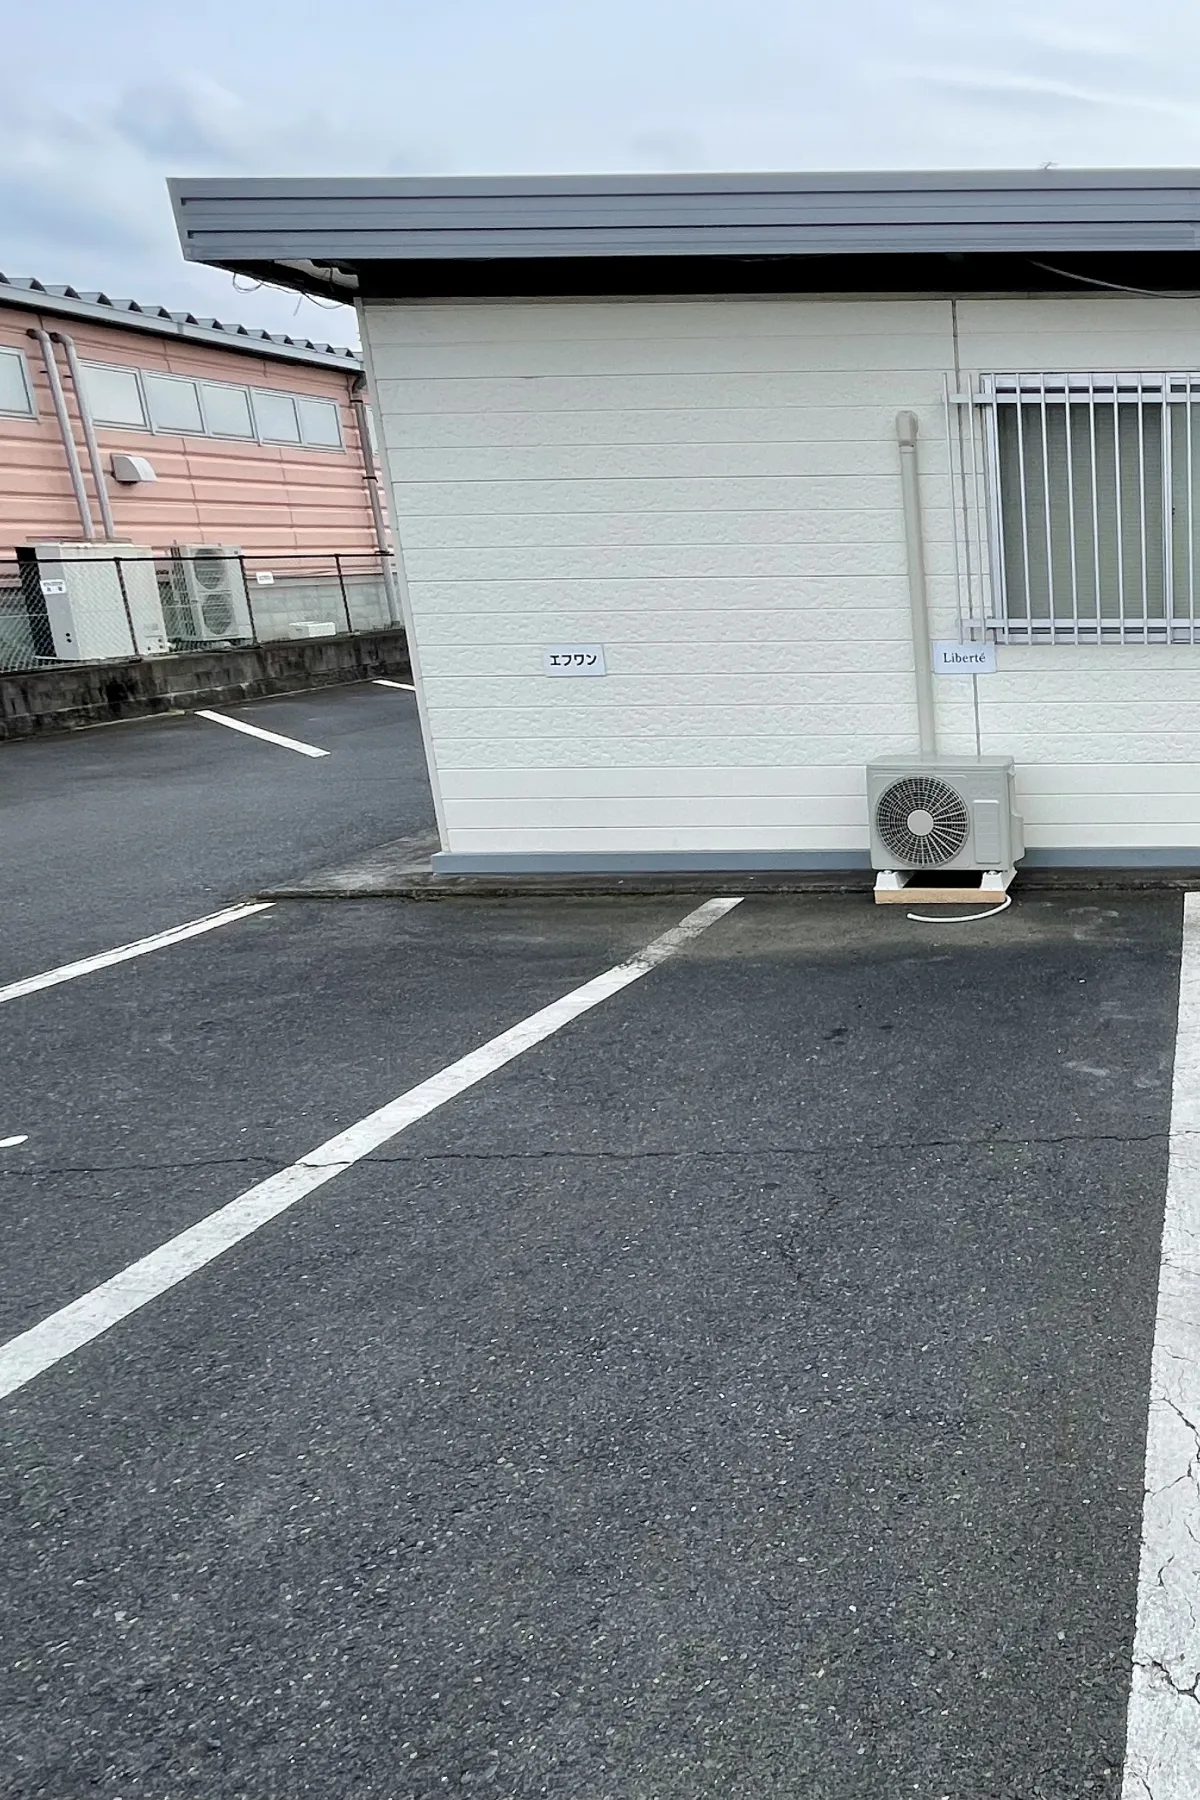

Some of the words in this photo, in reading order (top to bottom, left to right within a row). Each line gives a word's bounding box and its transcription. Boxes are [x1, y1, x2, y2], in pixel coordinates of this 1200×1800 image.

[549, 654, 597, 667] エフワン
[943, 652, 986, 663] Liberté
